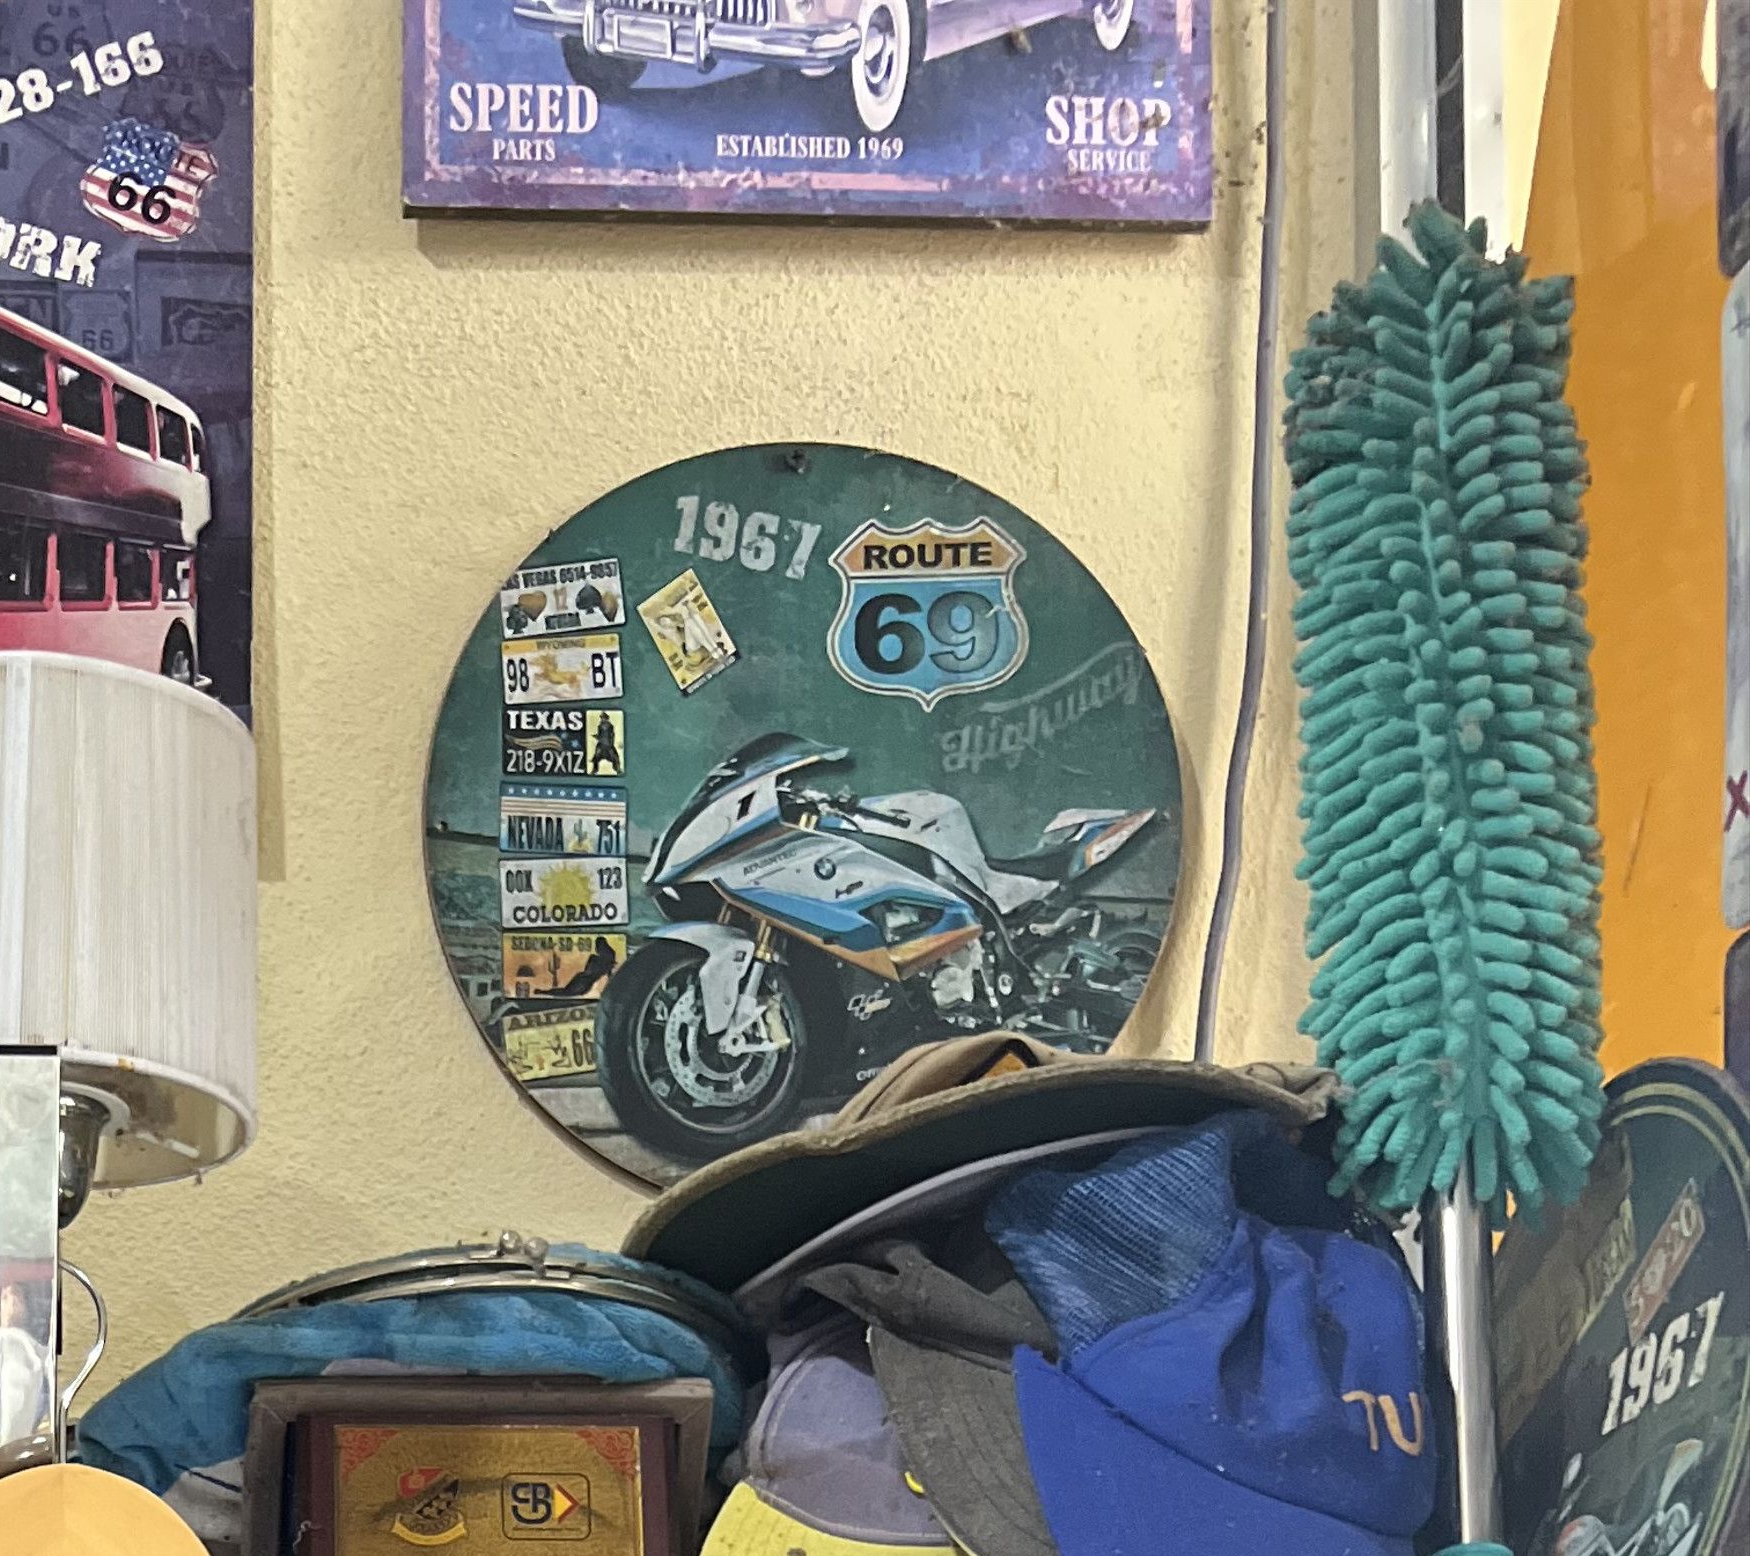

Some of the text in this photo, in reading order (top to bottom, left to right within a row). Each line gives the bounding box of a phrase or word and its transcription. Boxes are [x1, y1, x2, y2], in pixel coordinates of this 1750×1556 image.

[450, 82, 598, 134] SPEED
[1045, 94, 1172, 147] SHOP
[492, 138, 556, 162] PARTS
[716, 134, 904, 160] ESTABLISHED 1969
[1067, 148, 1151, 174] SERVICE
[107, 170, 177, 225] 66
[673, 495, 822, 580] 1967
[862, 541, 993, 571] ROUTE
[854, 590, 1000, 675] 69
[506, 651, 619, 693] 98 BT
[506, 709, 584, 731] TEXAS
[507, 814, 565, 851] NEVADA
[513, 902, 618, 924] COLORADO
[1601, 1291, 1724, 1436] 1967
